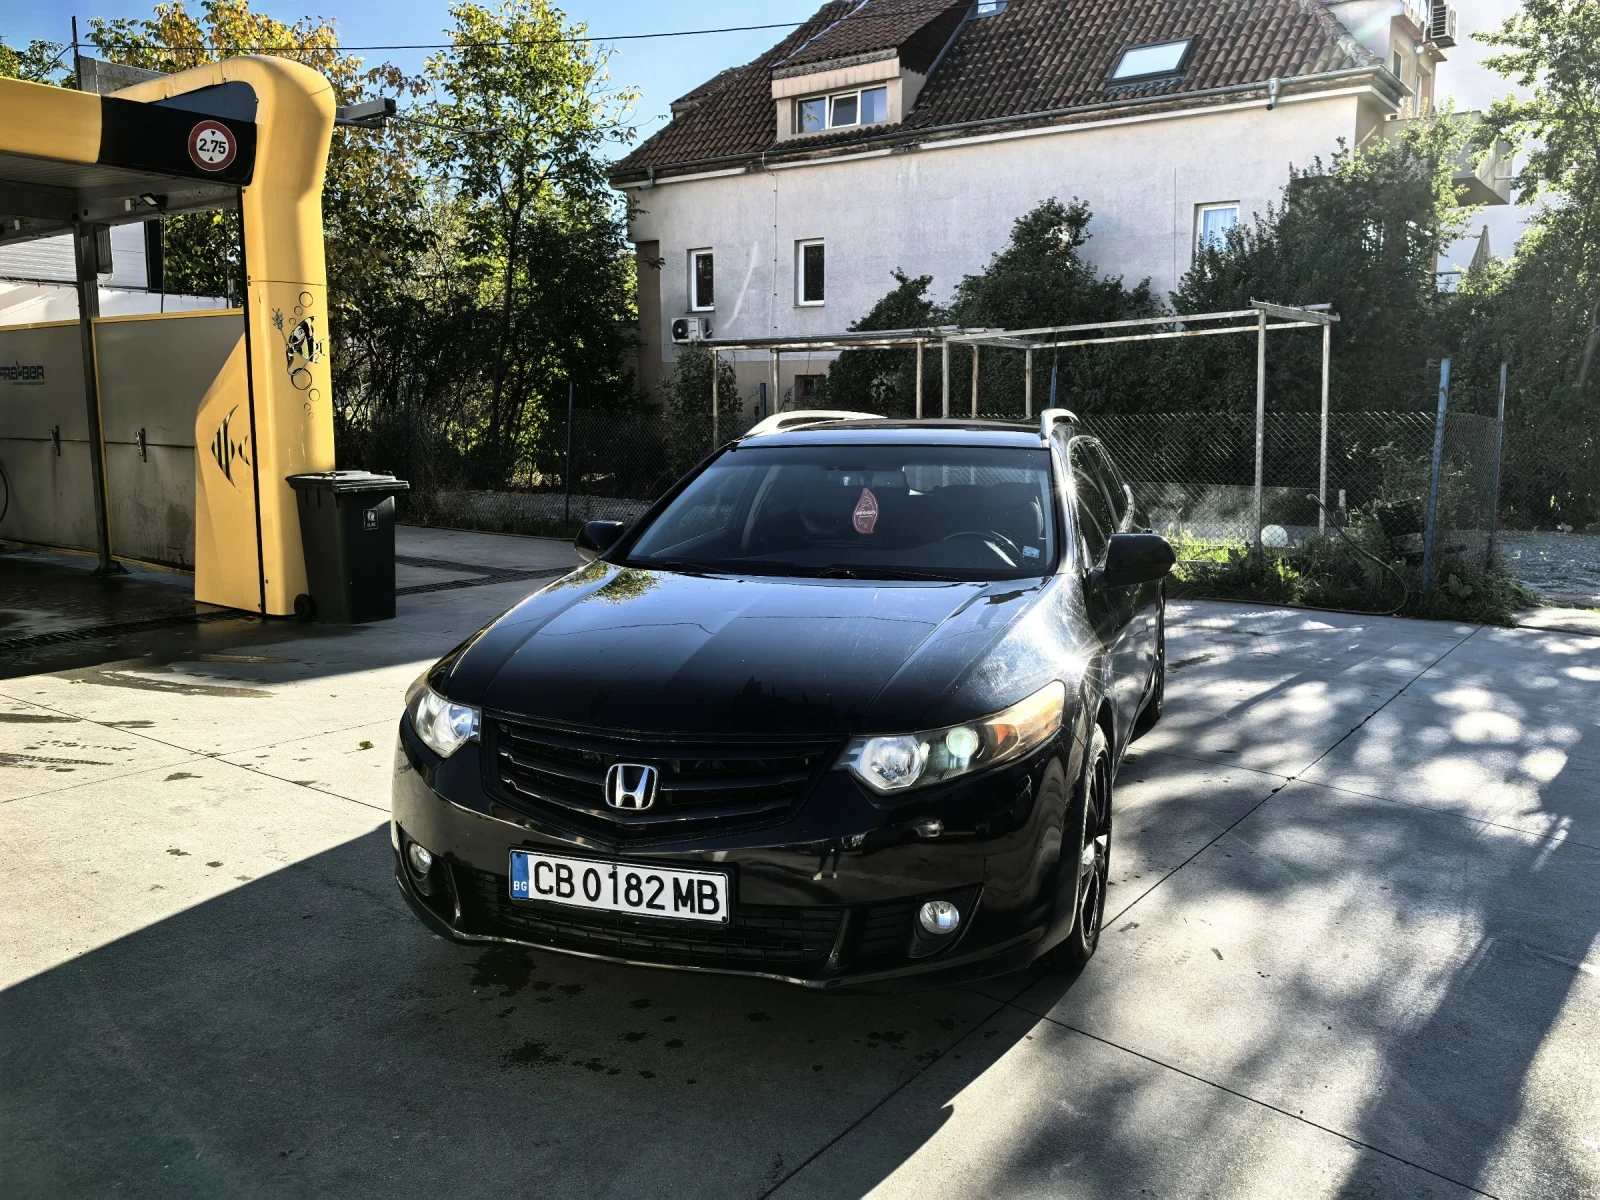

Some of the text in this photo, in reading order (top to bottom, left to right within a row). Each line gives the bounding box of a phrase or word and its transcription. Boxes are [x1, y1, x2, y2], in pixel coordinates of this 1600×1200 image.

[198, 138, 227, 154] 2.75
[513, 880, 528, 892] BG
[534, 861, 720, 915] CB 0182 MB
